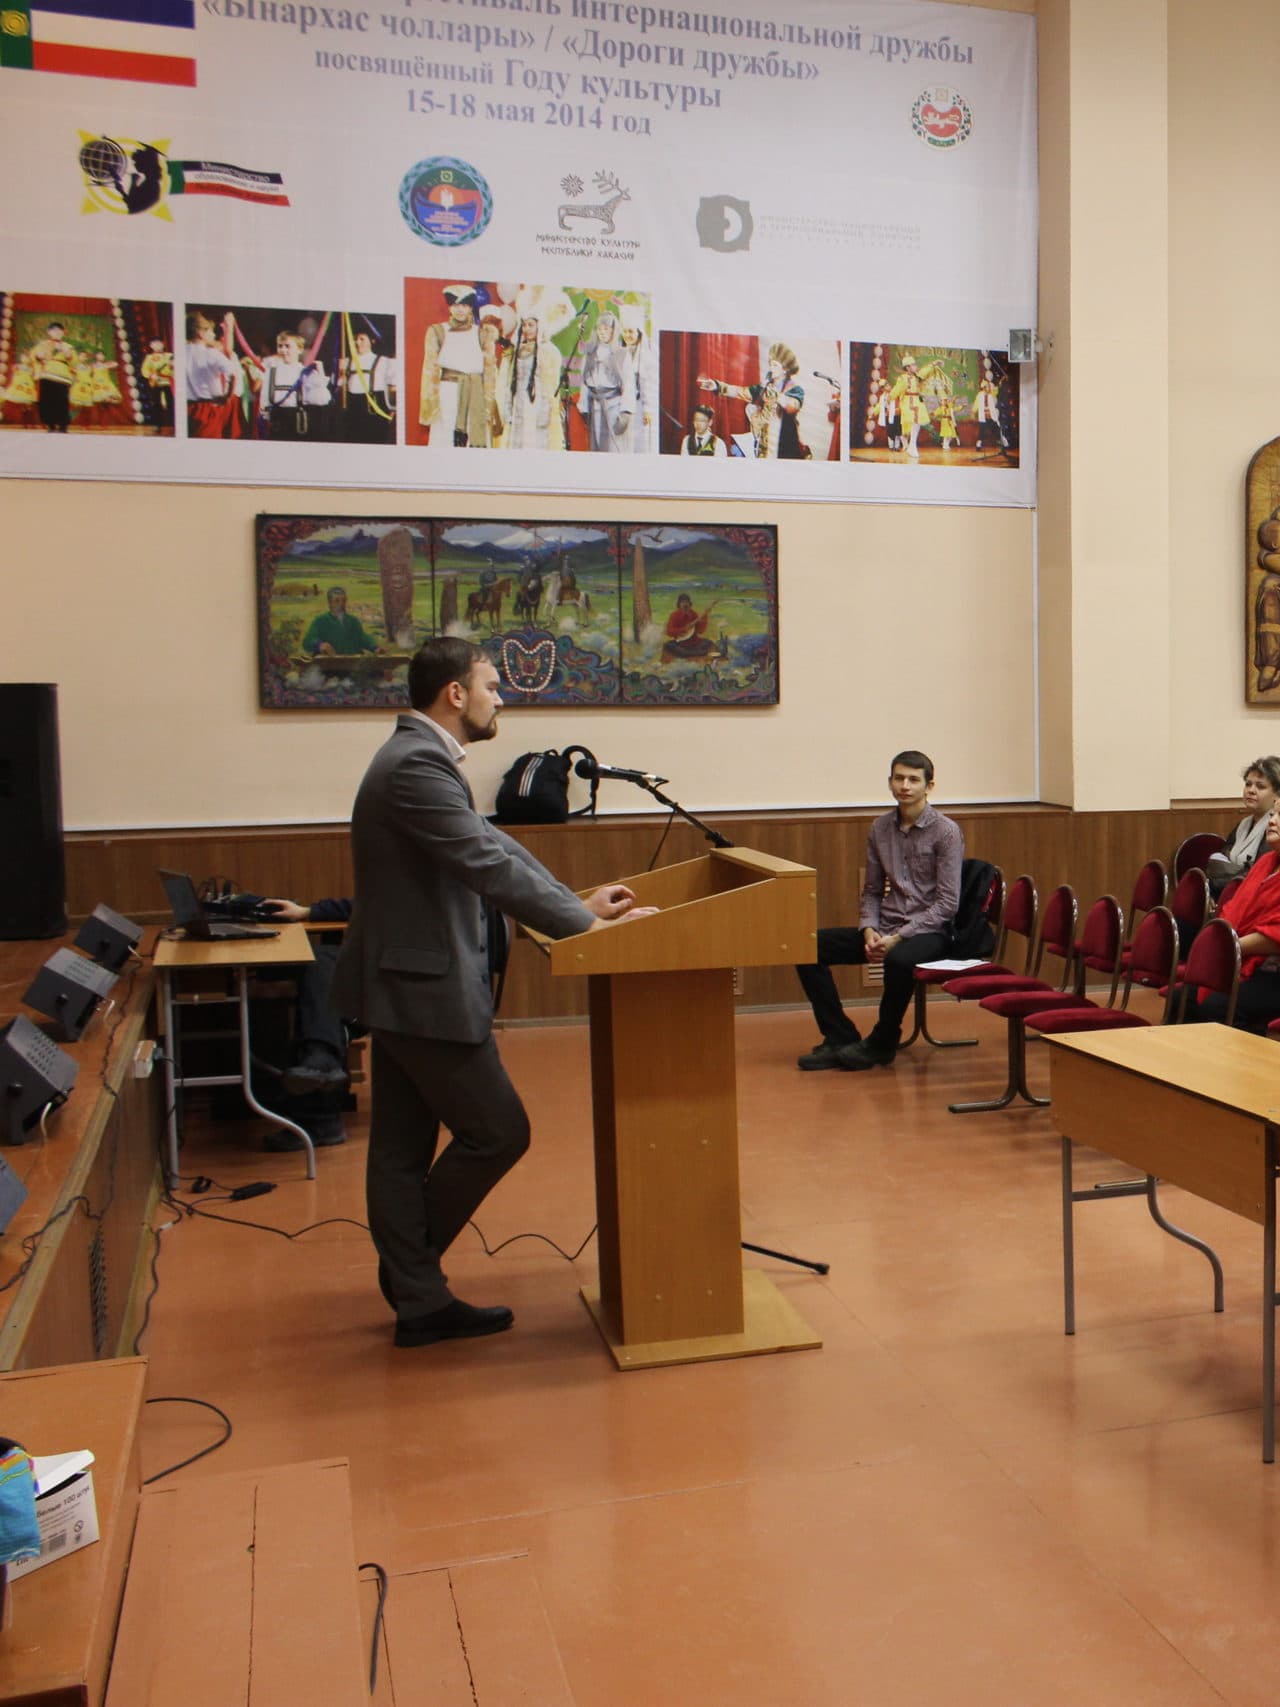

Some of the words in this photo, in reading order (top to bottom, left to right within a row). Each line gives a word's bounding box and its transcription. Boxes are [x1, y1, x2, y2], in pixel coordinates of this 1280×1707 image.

[381, 15, 536, 52] чоллары»
[562, 29, 684, 67] «Дороги
[693, 52, 820, 80] дружбы»
[869, 33, 974, 65] дружбы
[315, 49, 494, 84] посвящённый
[505, 60, 570, 98] Году
[581, 73, 720, 111] культуры
[407, 89, 476, 116] 15-18
[485, 104, 535, 122] мая
[545, 101, 602, 129] 2014
[612, 114, 651, 136] год
